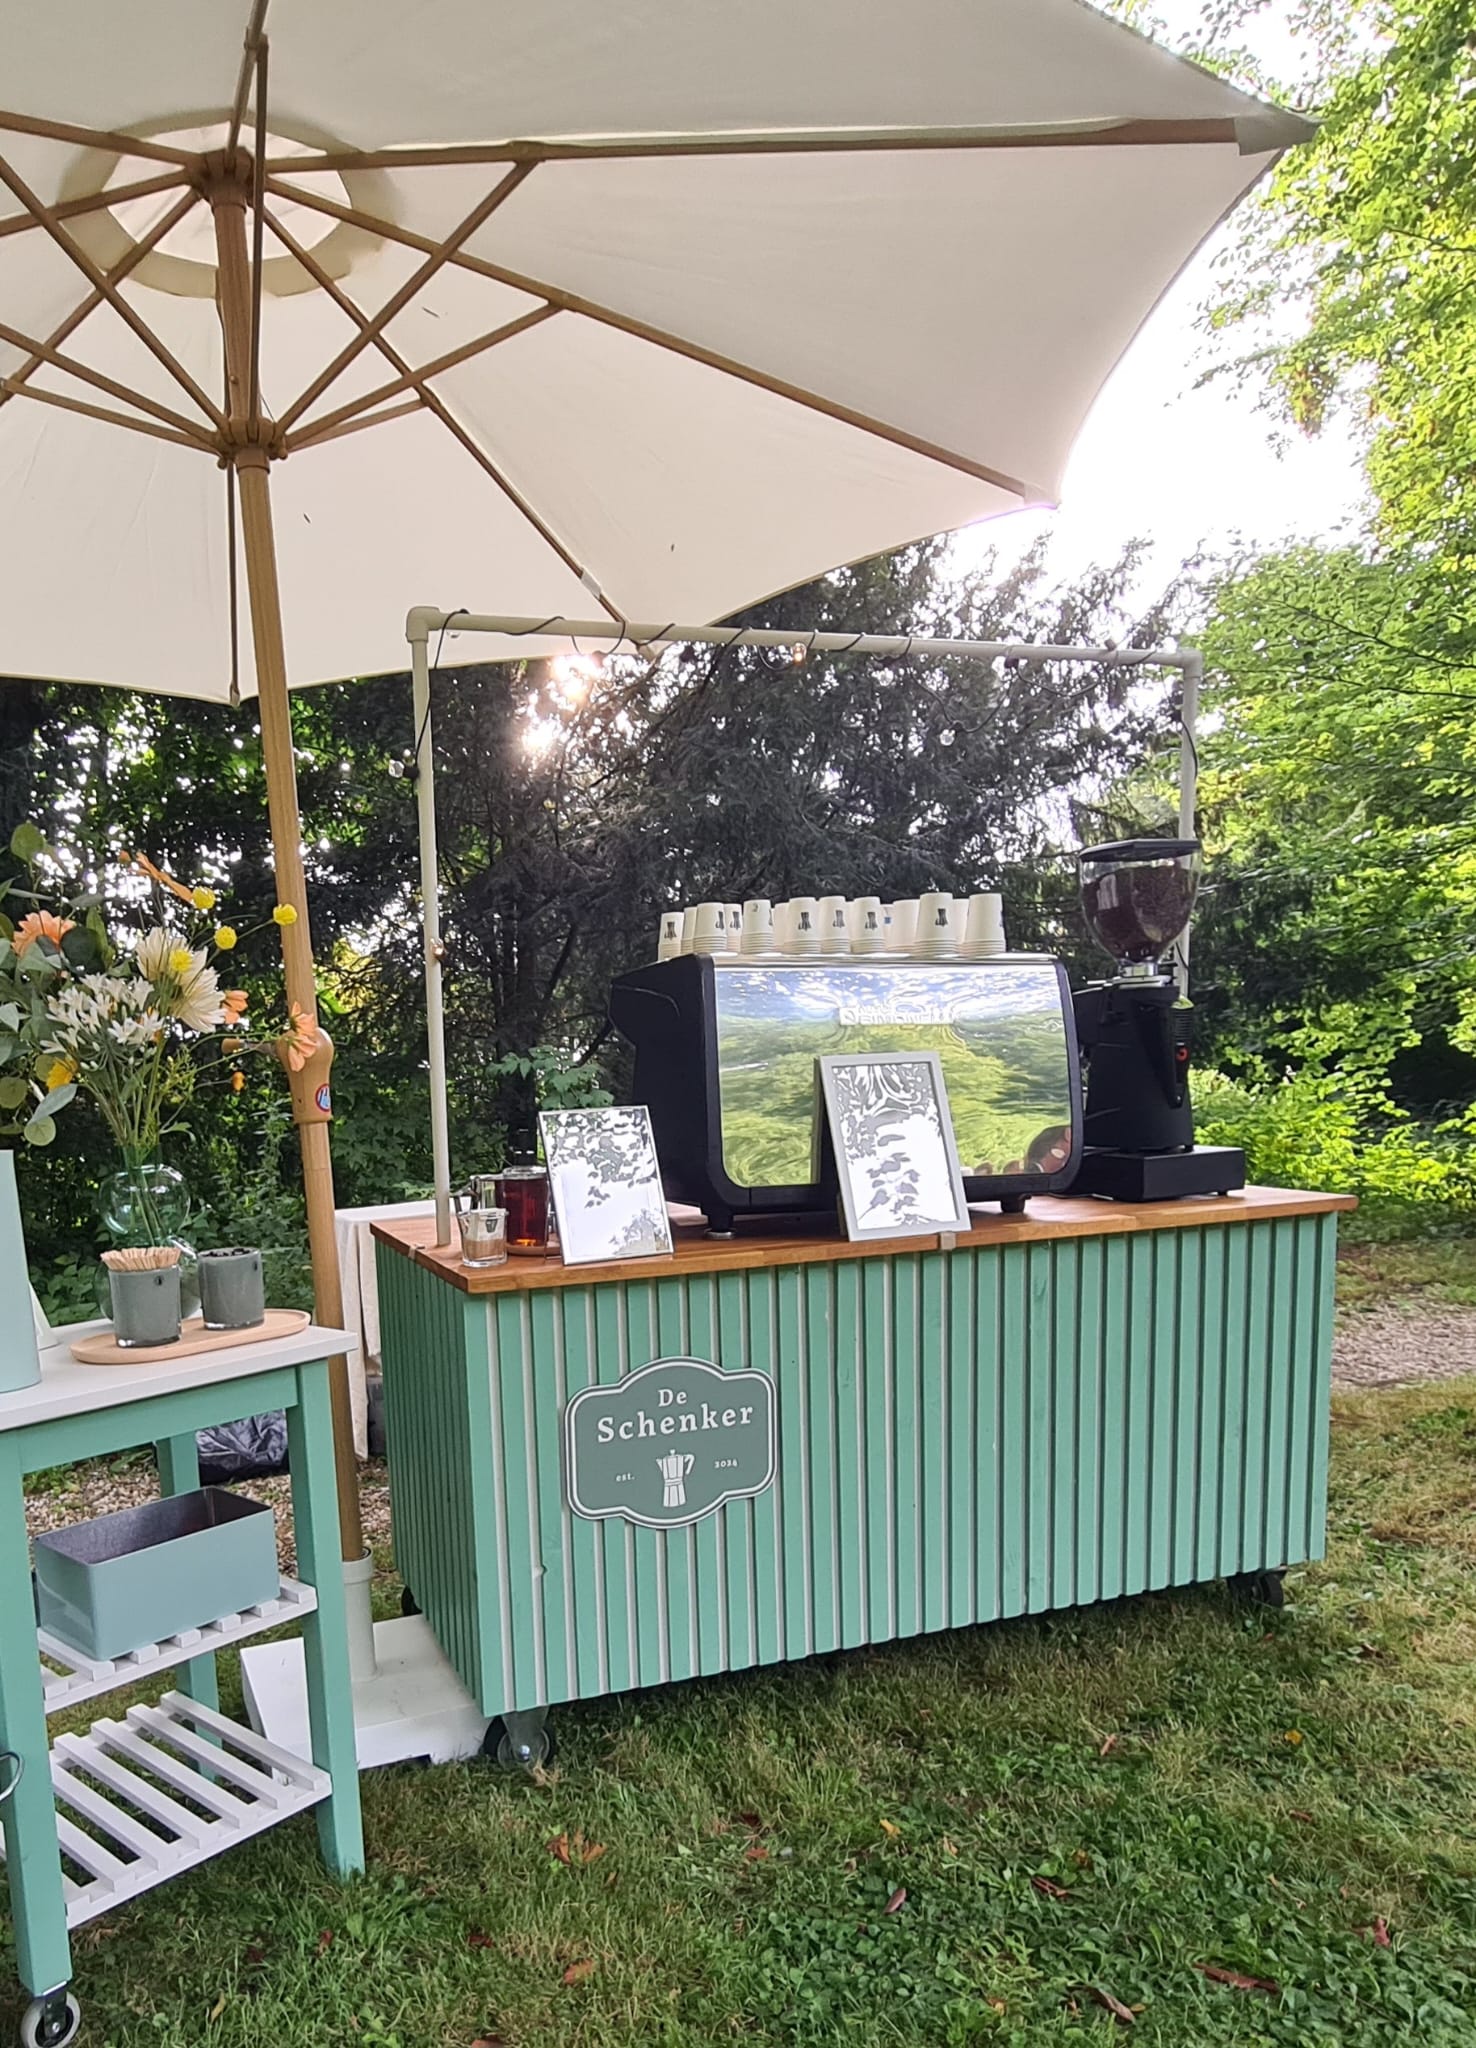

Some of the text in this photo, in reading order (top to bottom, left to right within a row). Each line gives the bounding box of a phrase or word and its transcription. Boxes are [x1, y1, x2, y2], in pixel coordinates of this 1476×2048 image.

[658, 1388, 688, 1407] De
[597, 1403, 754, 1443] Schenker
[616, 1472, 635, 1482] est.
